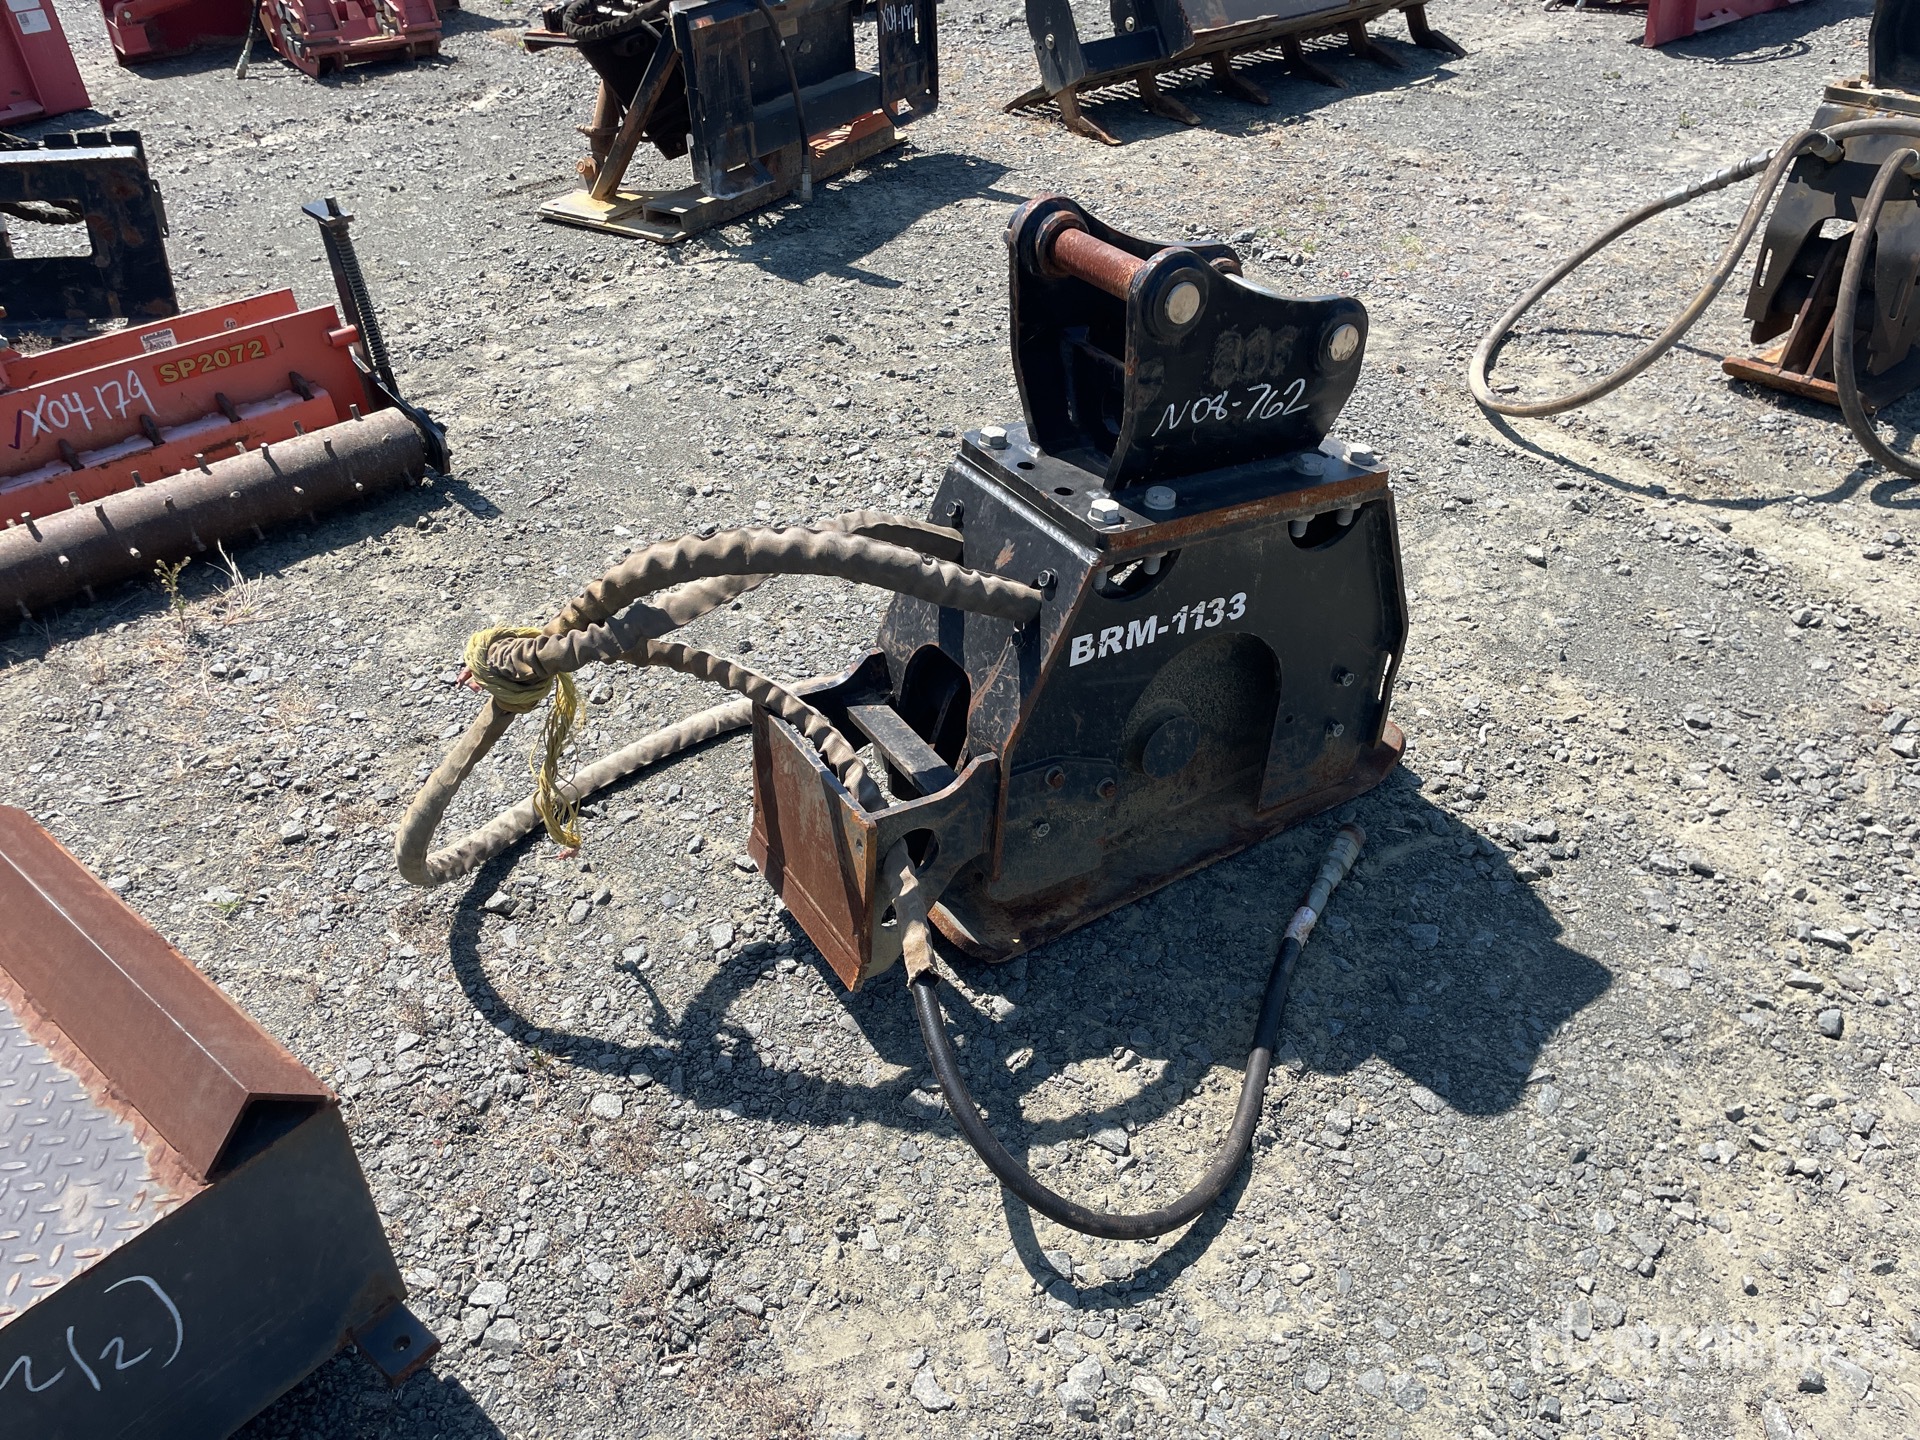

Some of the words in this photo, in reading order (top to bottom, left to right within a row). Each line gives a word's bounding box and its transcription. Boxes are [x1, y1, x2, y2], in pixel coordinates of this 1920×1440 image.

[159, 340, 265, 383] SP2072
[22, 369, 160, 437] X04179
[1069, 592, 1247, 667] BRM-1133
